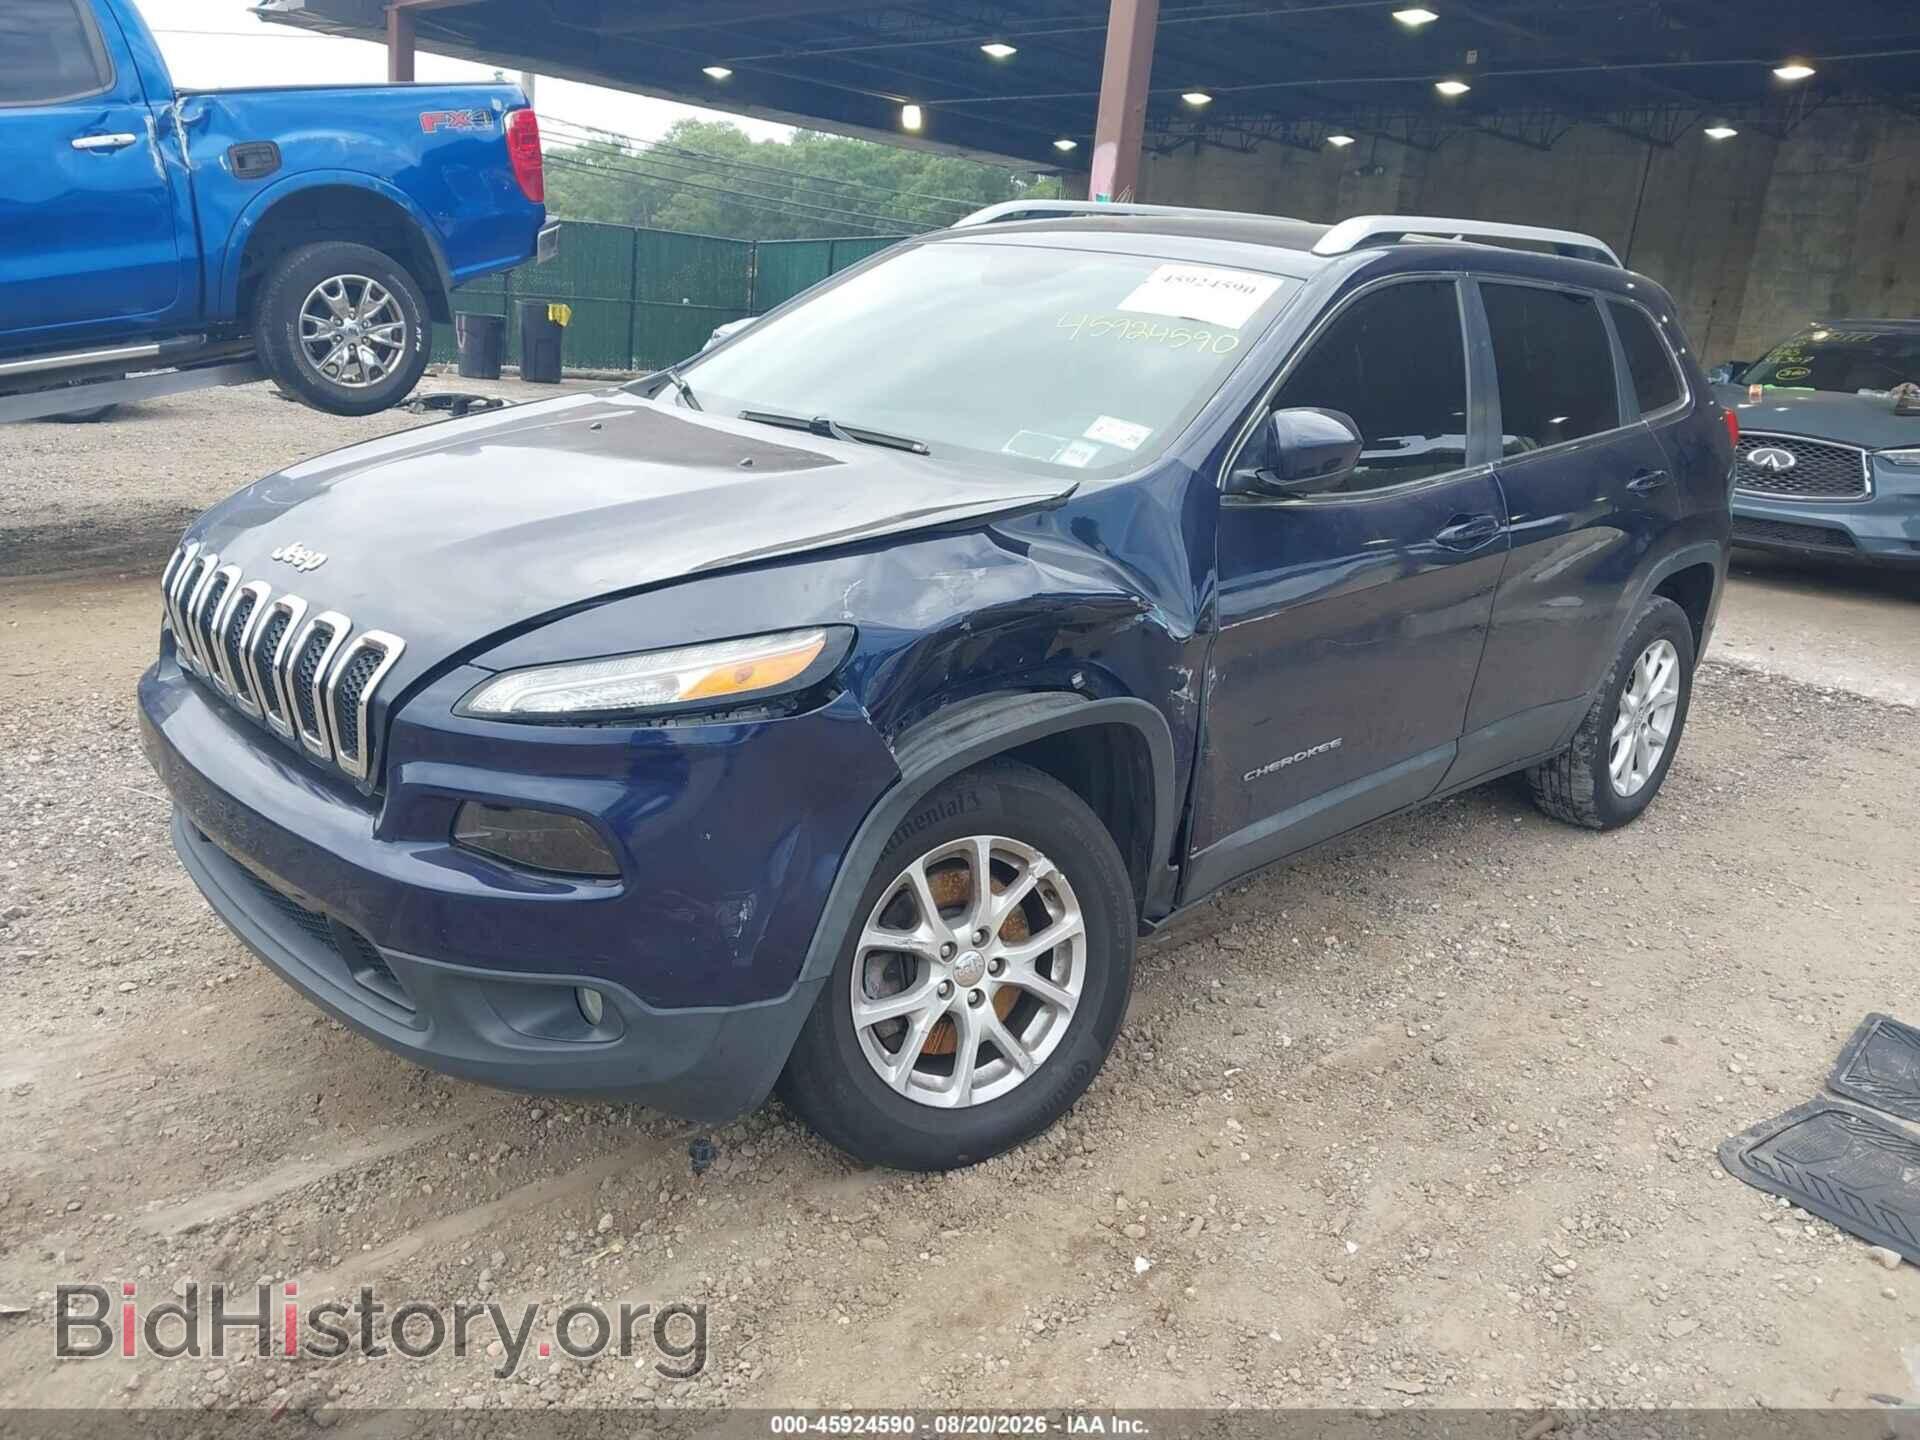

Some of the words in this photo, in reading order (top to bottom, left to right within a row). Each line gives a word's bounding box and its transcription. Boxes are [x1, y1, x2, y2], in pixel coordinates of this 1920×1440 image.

[419, 111, 493, 134] FX4
[1055, 311, 1240, 354] 45924590
[271, 541, 328, 573] Jeep
[1243, 737, 1343, 781] CHEROKEE
